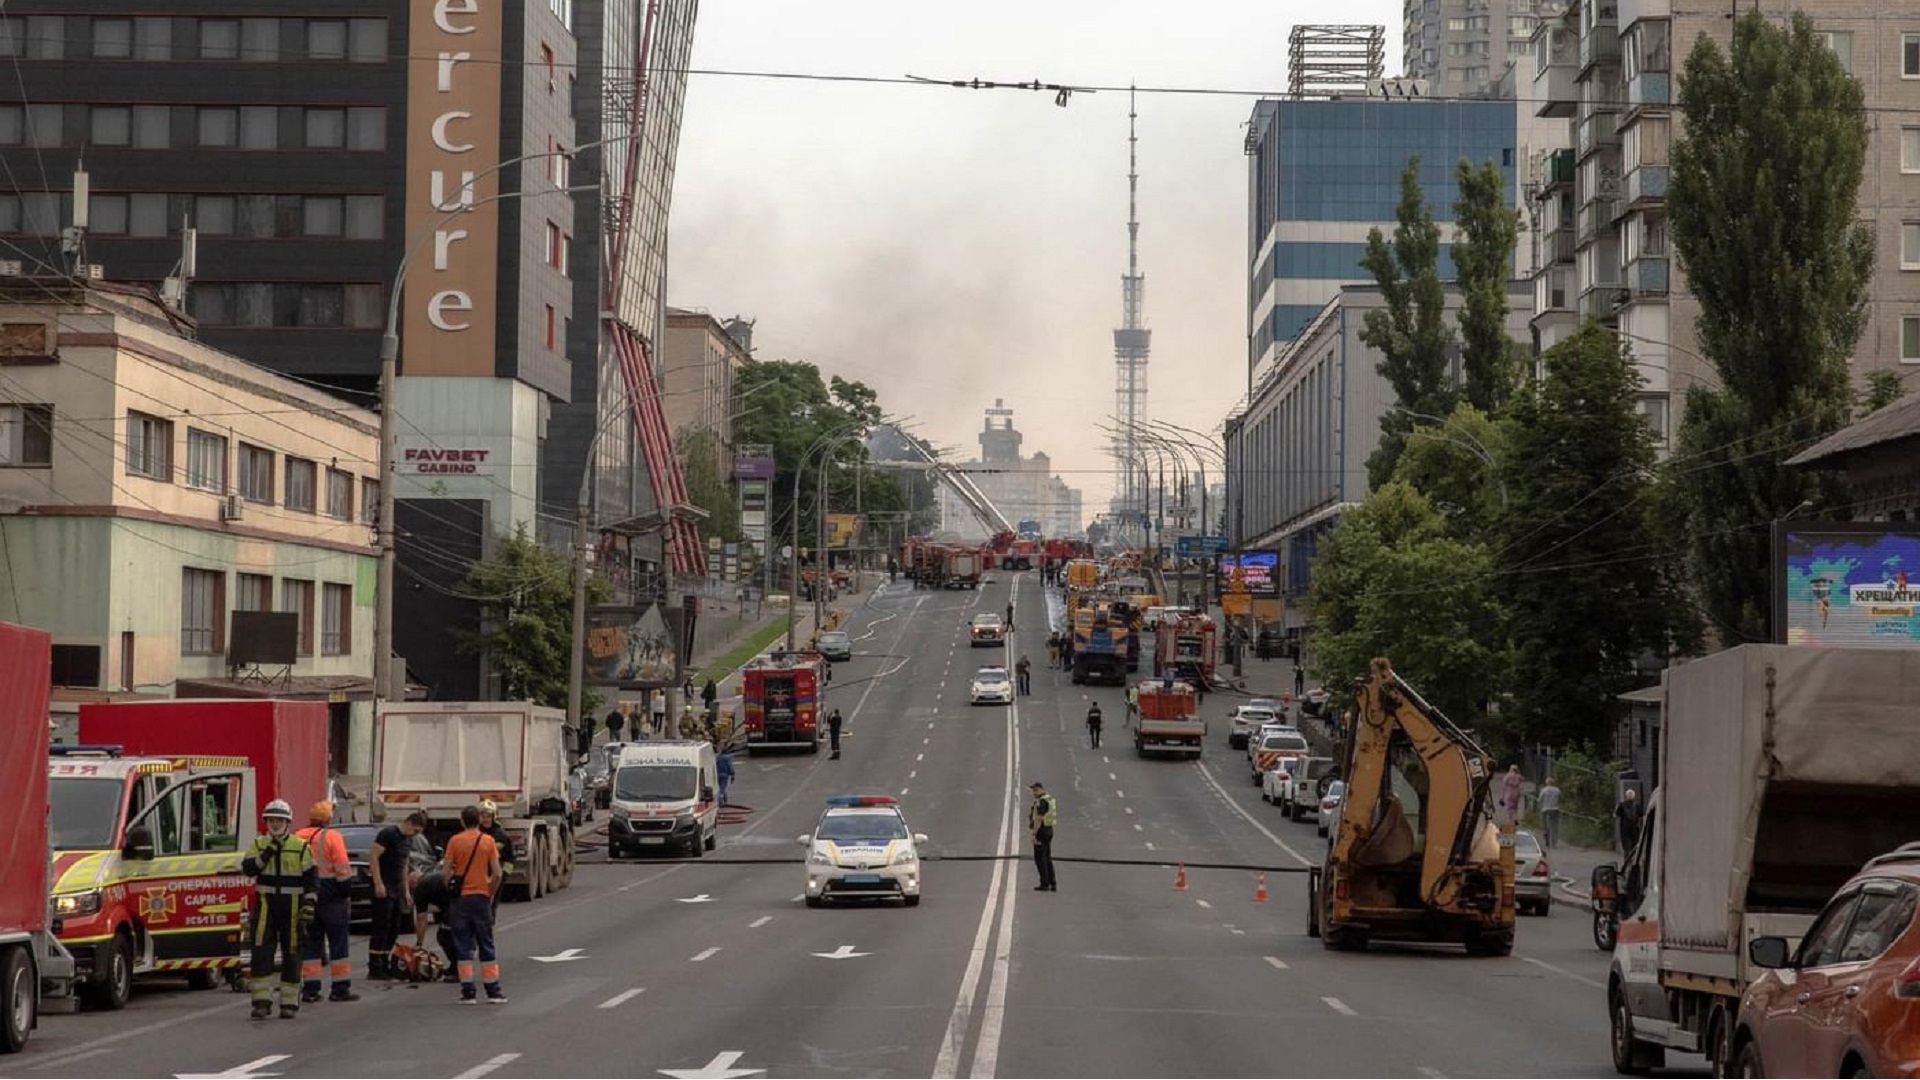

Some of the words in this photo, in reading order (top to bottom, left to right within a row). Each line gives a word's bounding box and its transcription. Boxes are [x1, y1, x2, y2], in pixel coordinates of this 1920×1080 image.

[405, 448, 489, 462] FAVBET
[418, 463, 476, 473] CASINO
[1855, 590, 1920, 602] ХРЕЩАТИ
[184, 894, 226, 905] САРМ-С
